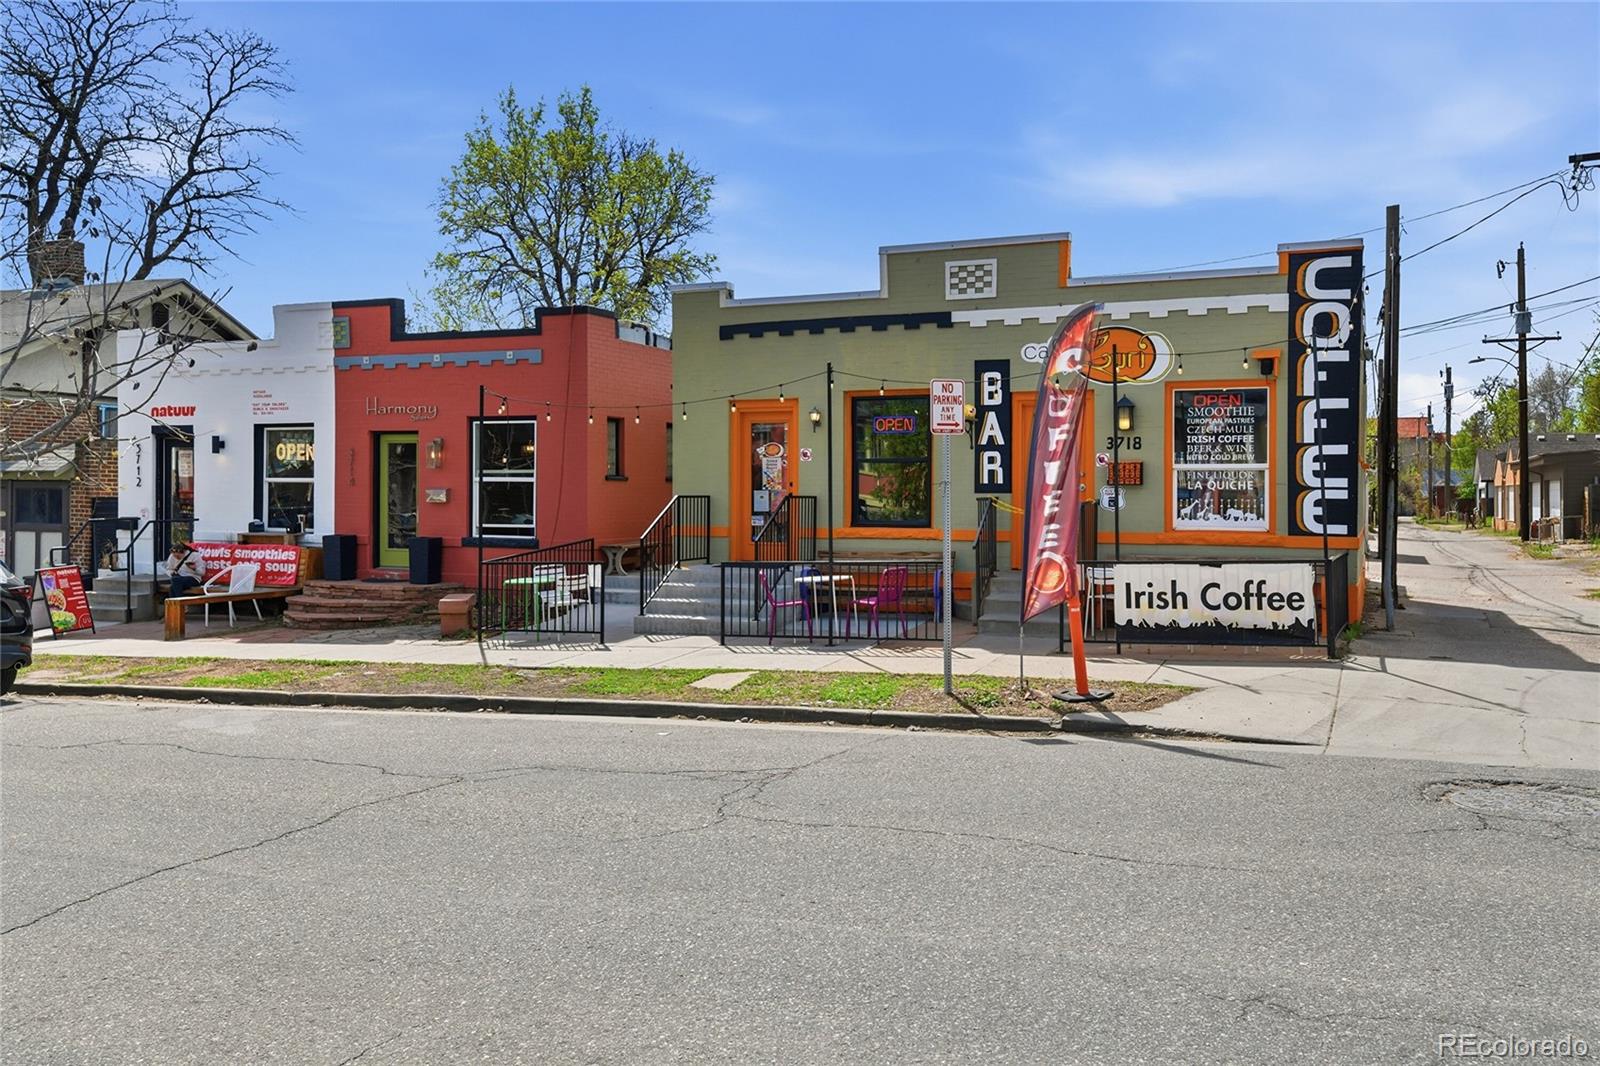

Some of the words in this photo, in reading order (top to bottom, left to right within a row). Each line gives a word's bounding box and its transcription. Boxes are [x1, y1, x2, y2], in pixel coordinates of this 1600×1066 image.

[1024, 345, 1049, 360] ca
[941, 383, 954, 394] NO
[933, 394, 963, 405] PARKING
[1194, 394, 1241, 406] OPEN
[1296, 256, 1352, 535] COFFEE
[151, 405, 196, 417] natuur
[366, 396, 437, 418] Harmony
[1187, 407, 1255, 417] SMOOTHIE
[875, 418, 913, 431] OPEN
[978, 371, 1004, 485] BAR
[1106, 436, 1141, 450] 3718
[1186, 435, 1216, 443] IRISH
[1218, 434, 1255, 443] COFFEE
[276, 443, 316, 461] OPEN
[1225, 444, 1255, 452] WINE
[1187, 471, 1213, 479] FINE
[1213, 471, 1255, 480] LIQUOR
[1187, 481, 1203, 490] LA
[1207, 481, 1254, 491] QUICHE
[199, 547, 231, 558] bowls
[234, 549, 296, 560] smoothies
[265, 562, 296, 574] soup
[1125, 580, 1188, 610] Irish
[1200, 579, 1305, 611] Coffee
